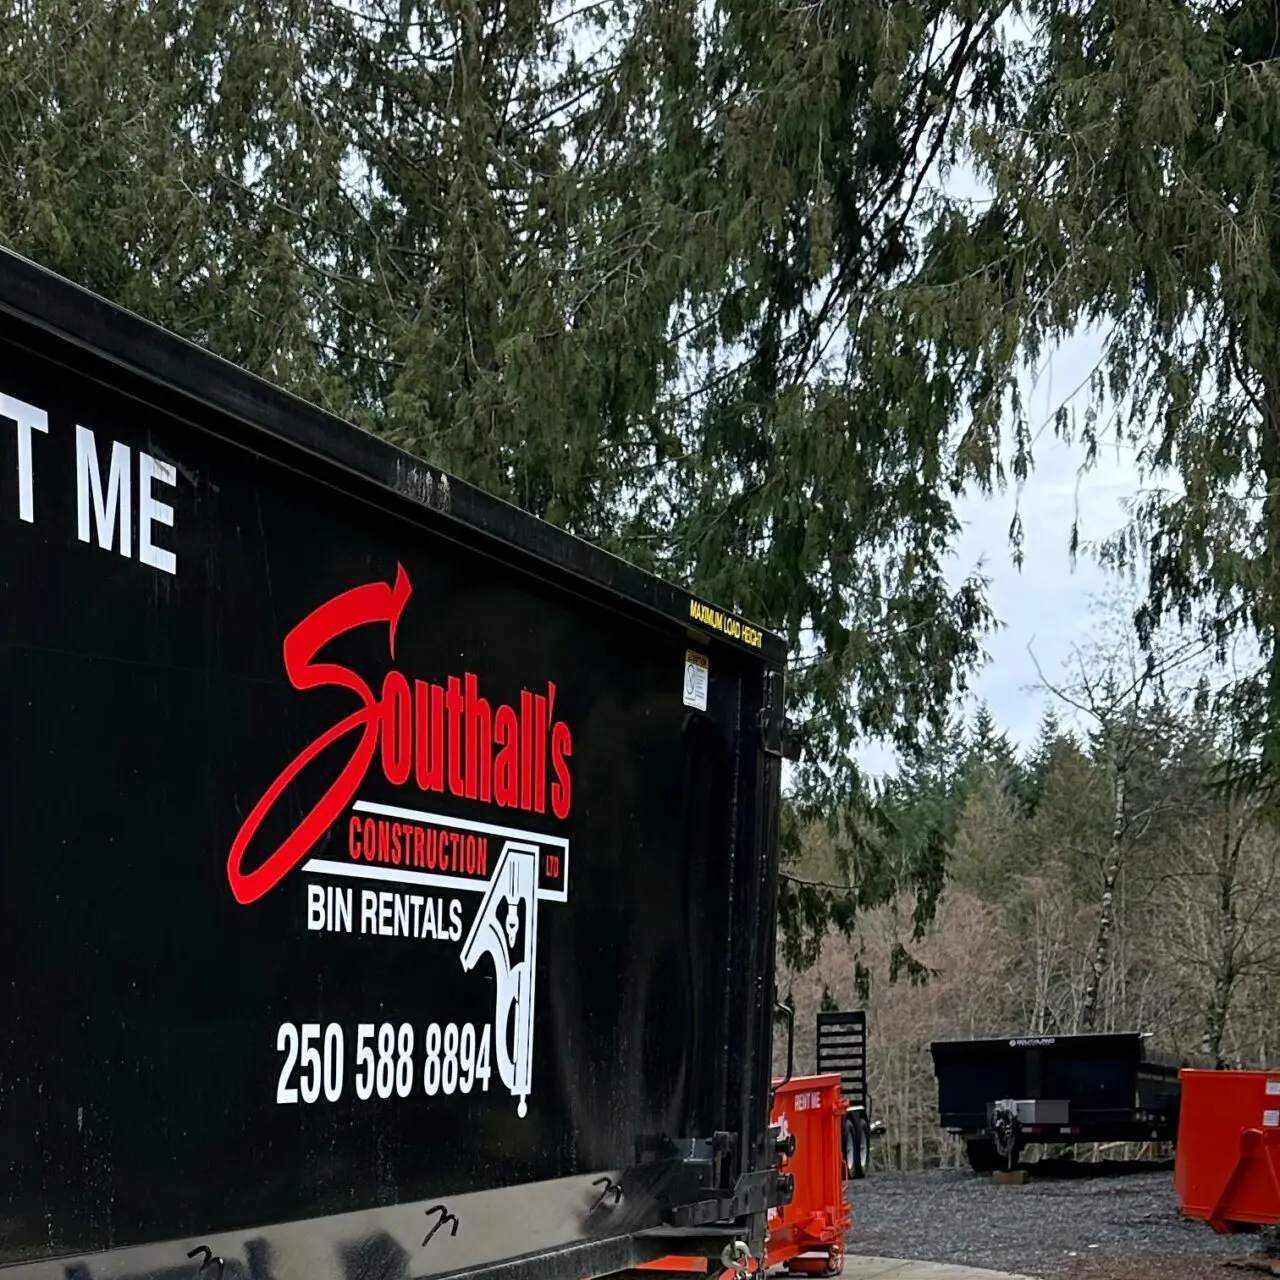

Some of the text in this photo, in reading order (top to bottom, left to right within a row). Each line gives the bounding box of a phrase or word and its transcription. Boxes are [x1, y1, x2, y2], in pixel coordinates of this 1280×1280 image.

[75, 424, 177, 575] ME
[690, 600, 763, 648] MAXIMUM LOAD HEIGHT
[226, 560, 572, 904] Southall's
[348, 816, 559, 878] CONSTRUCTION LTD
[308, 884, 463, 942] BIN RENTALS
[277, 1022, 492, 1103] 250 588 8894
